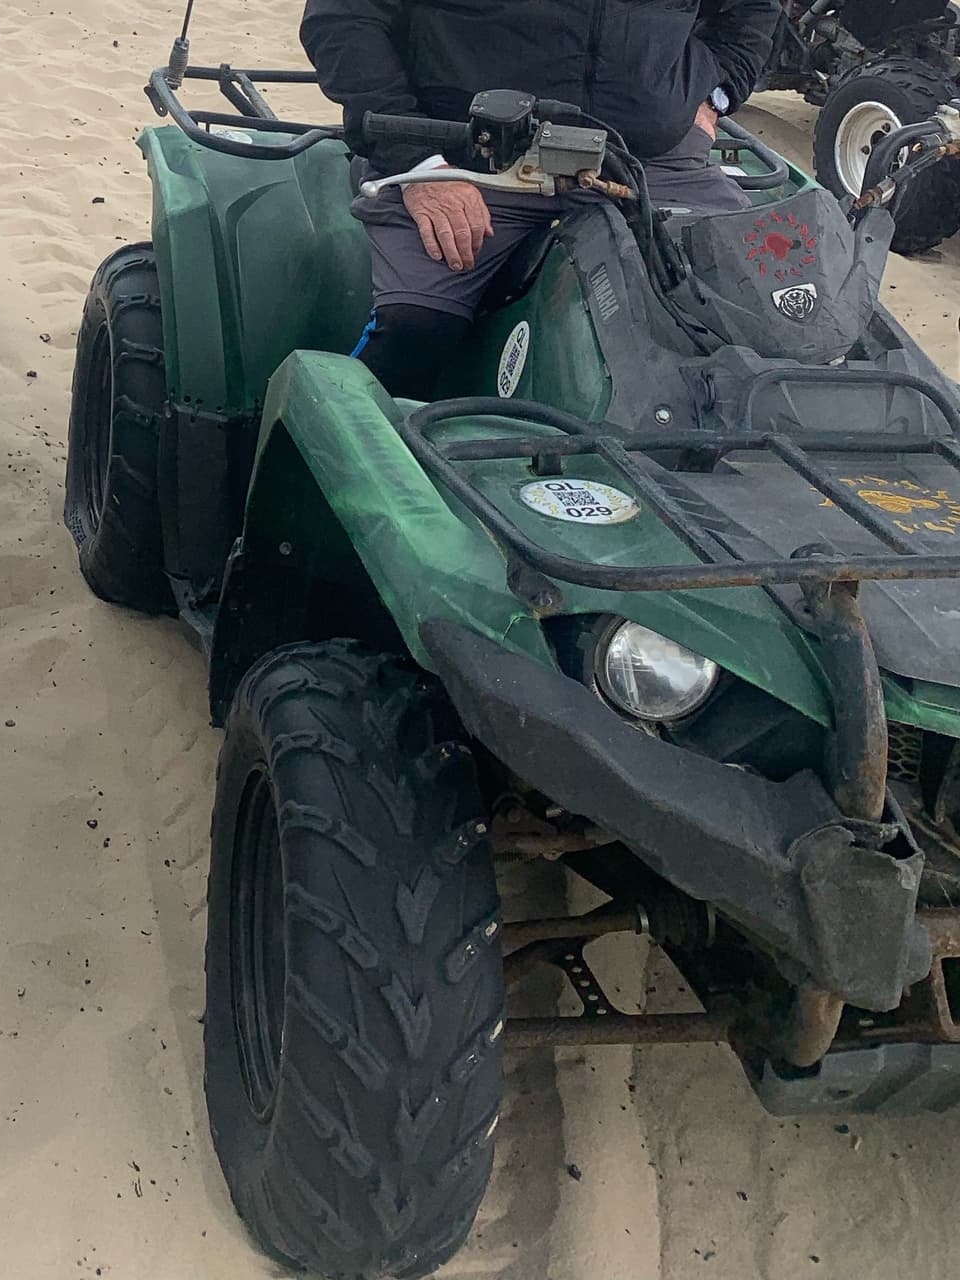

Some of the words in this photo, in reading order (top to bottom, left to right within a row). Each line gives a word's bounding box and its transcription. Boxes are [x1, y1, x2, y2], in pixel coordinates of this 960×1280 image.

[591, 264, 619, 320] YAMAHA
[544, 482, 584, 492] QL
[565, 506, 613, 518] 029
